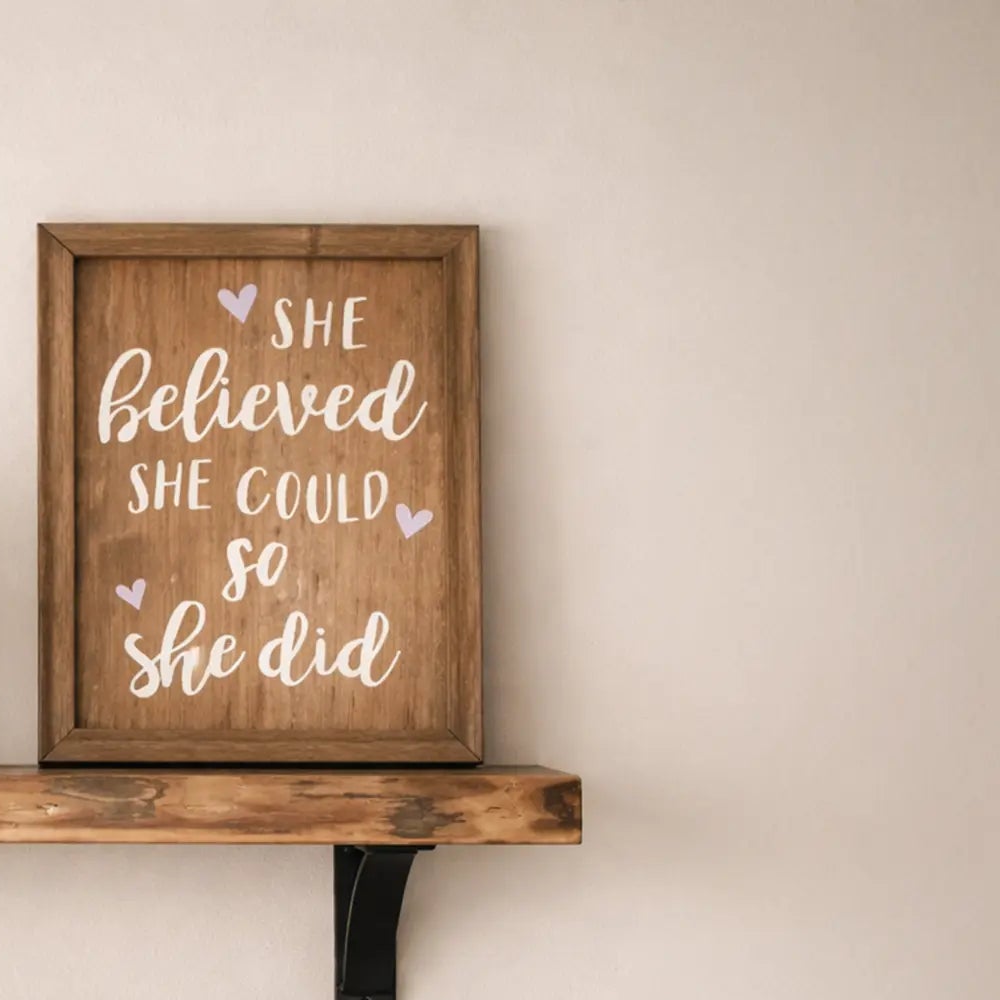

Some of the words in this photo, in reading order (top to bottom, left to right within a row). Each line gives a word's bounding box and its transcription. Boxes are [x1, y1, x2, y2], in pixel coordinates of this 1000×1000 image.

[270, 296, 368, 350] SHE
[98, 346, 428, 444] believed
[127, 457, 213, 514] SHE
[235, 465, 390, 525] COULD
[123, 599, 247, 698] she
[256, 609, 402, 688] did
